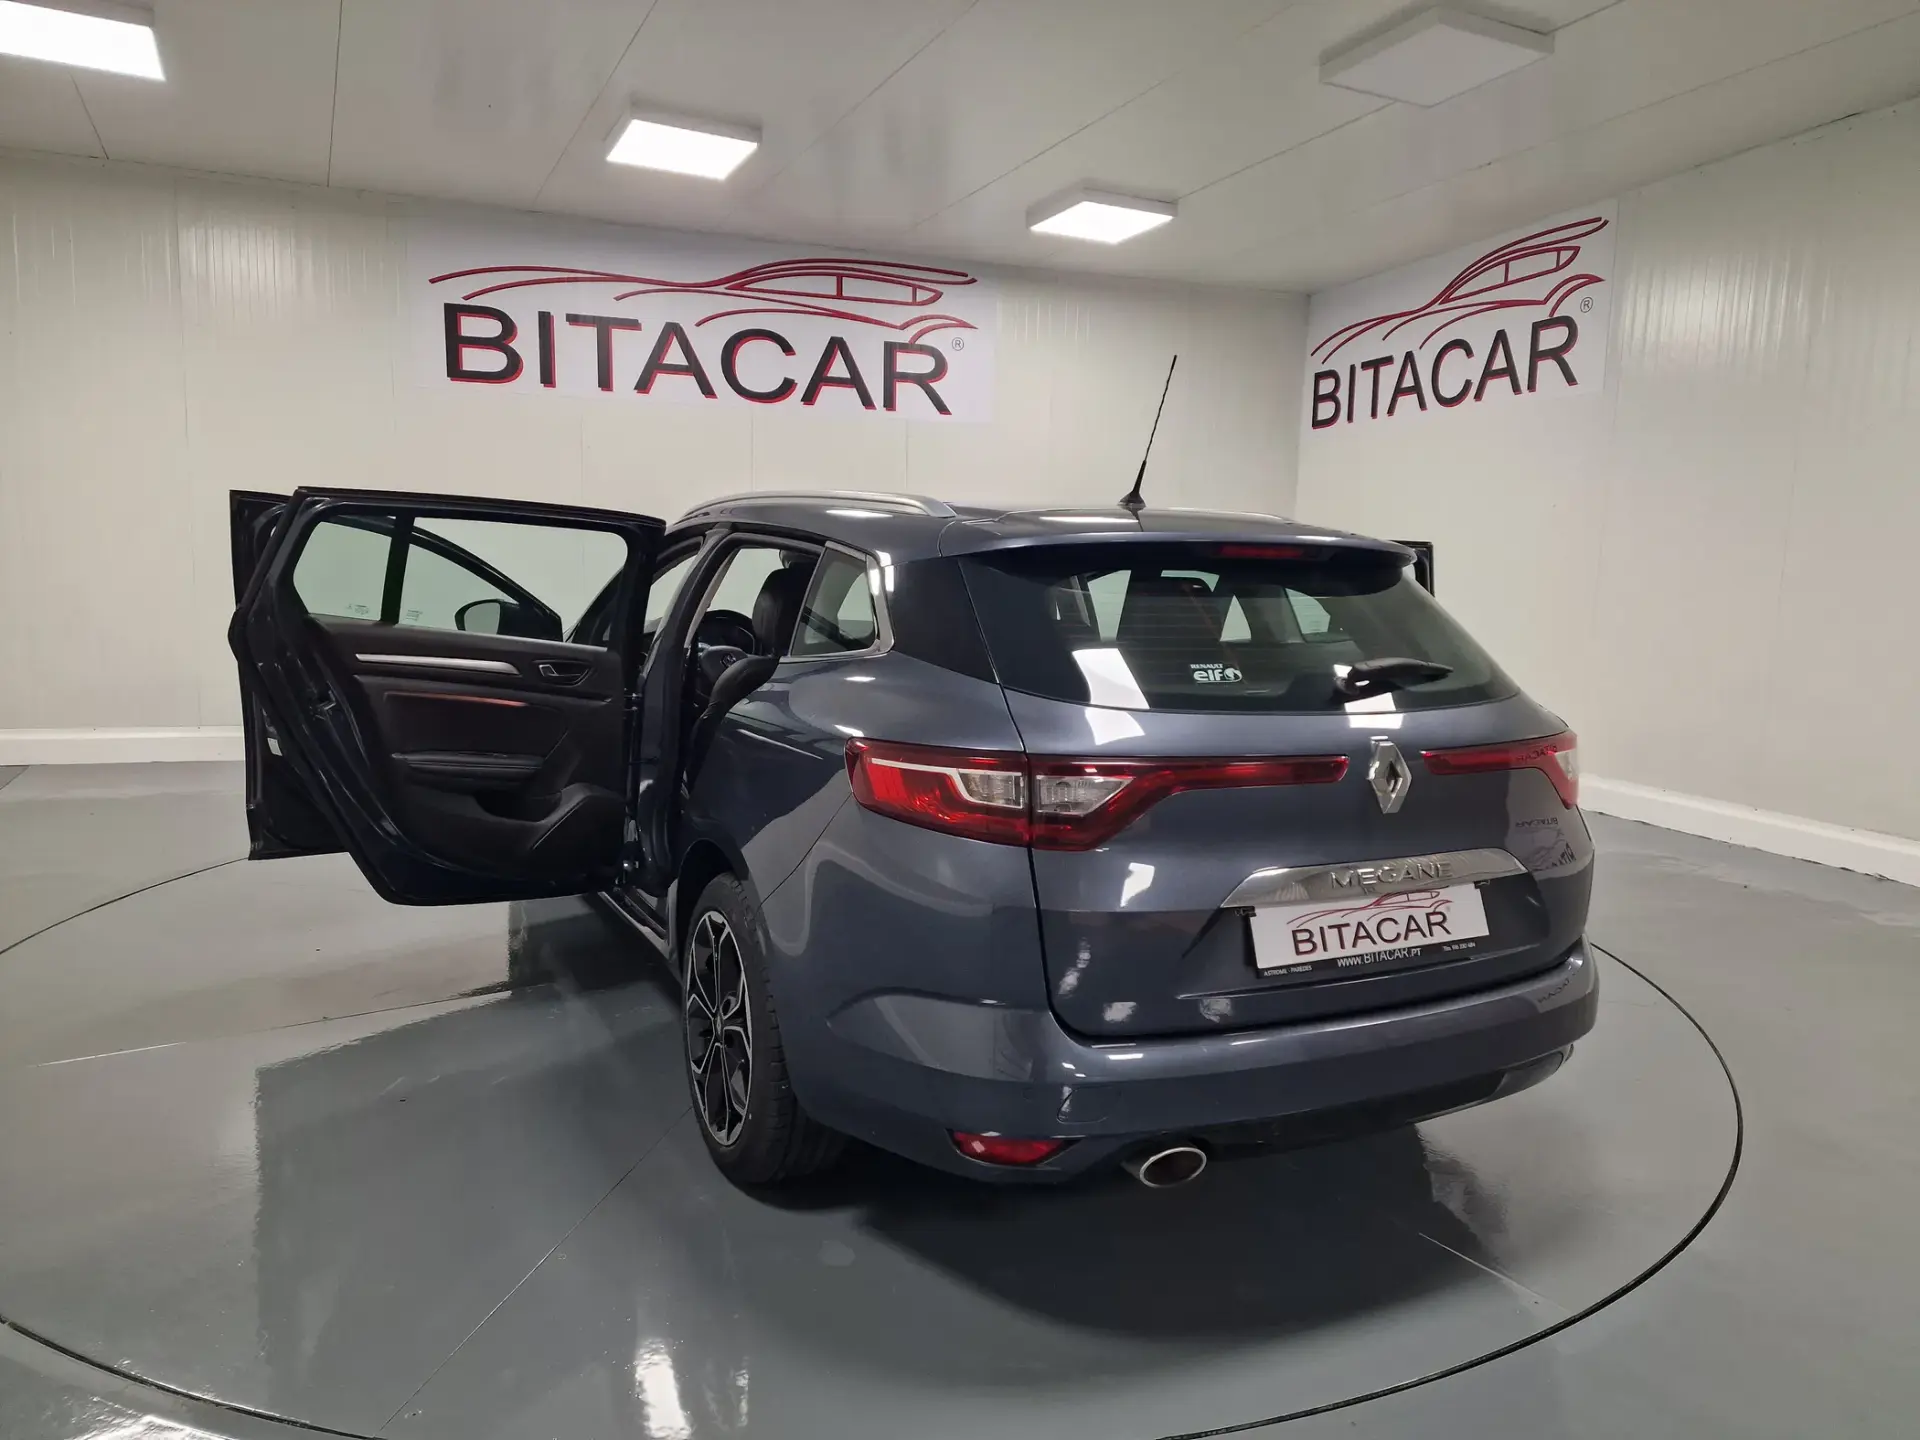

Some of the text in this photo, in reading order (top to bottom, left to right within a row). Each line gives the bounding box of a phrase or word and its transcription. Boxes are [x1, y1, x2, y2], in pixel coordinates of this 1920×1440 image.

[443, 302, 953, 416] BITACAR
[1311, 315, 1579, 430] BITACAR
[1330, 862, 1454, 889] MEGANE
[1291, 911, 1452, 957] BITACAR
